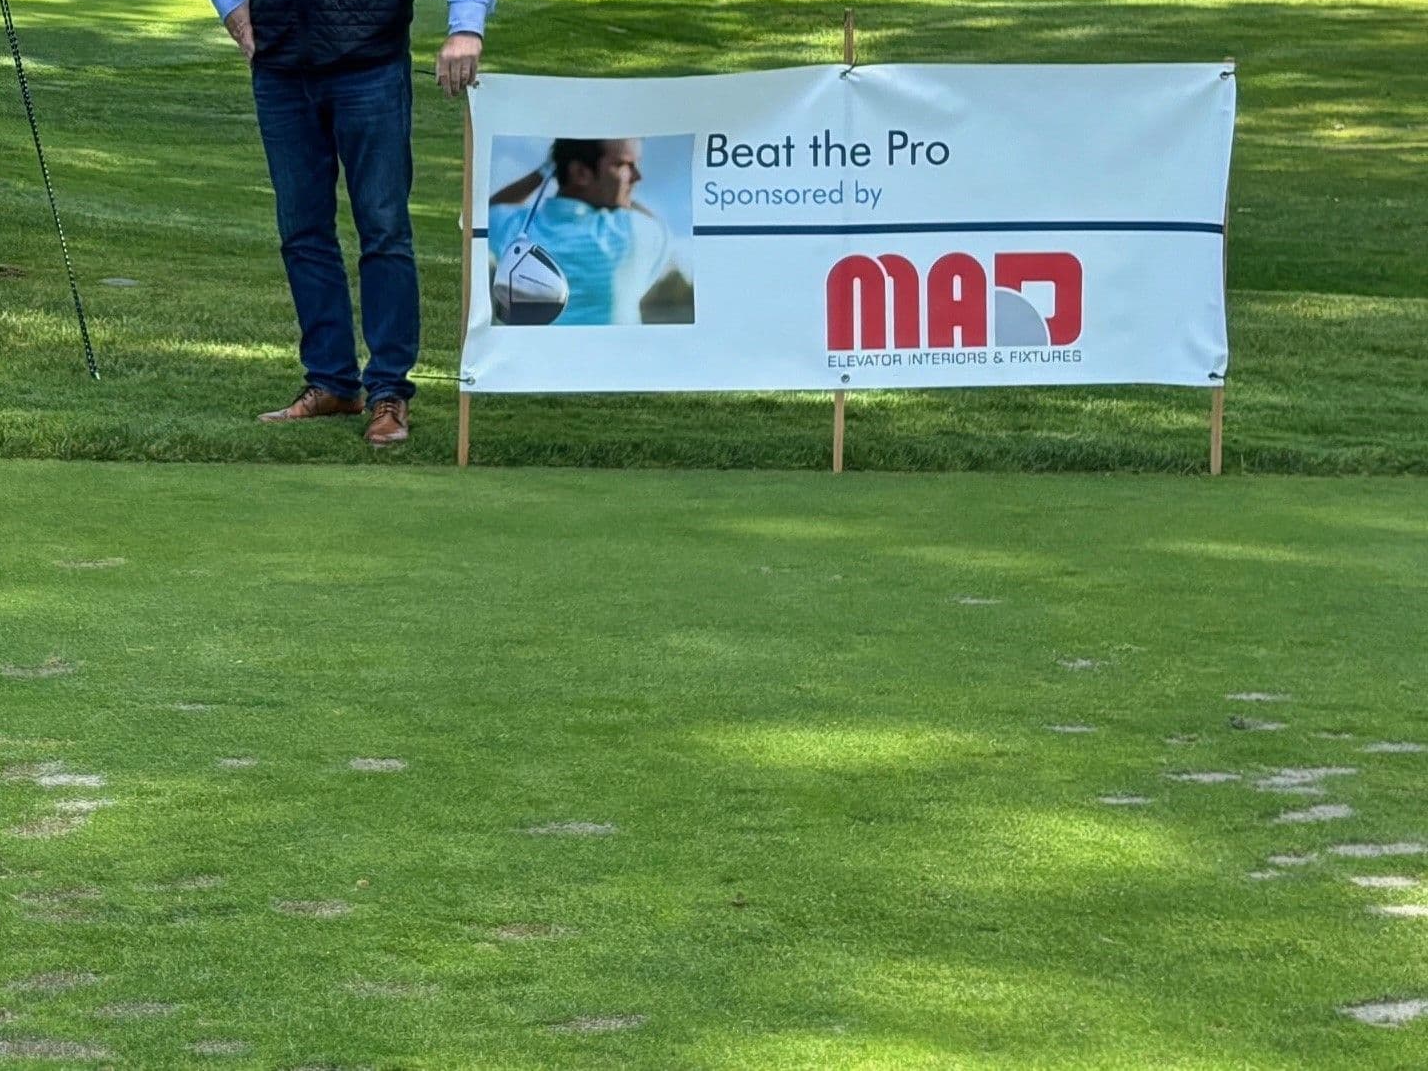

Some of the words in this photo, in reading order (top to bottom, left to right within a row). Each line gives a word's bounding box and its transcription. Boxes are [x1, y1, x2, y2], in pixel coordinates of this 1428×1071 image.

[706, 133, 795, 168] Beat
[809, 129, 871, 167] the
[887, 129, 950, 166] Pro
[704, 180, 844, 211] Sponsored
[854, 179, 883, 211] by
[826, 252, 1083, 351] MAD
[827, 353, 902, 368] ELEVATOR
[908, 352, 988, 366] INTERIORS
[994, 351, 1005, 364] &
[1010, 349, 1082, 363] FIXTURES
